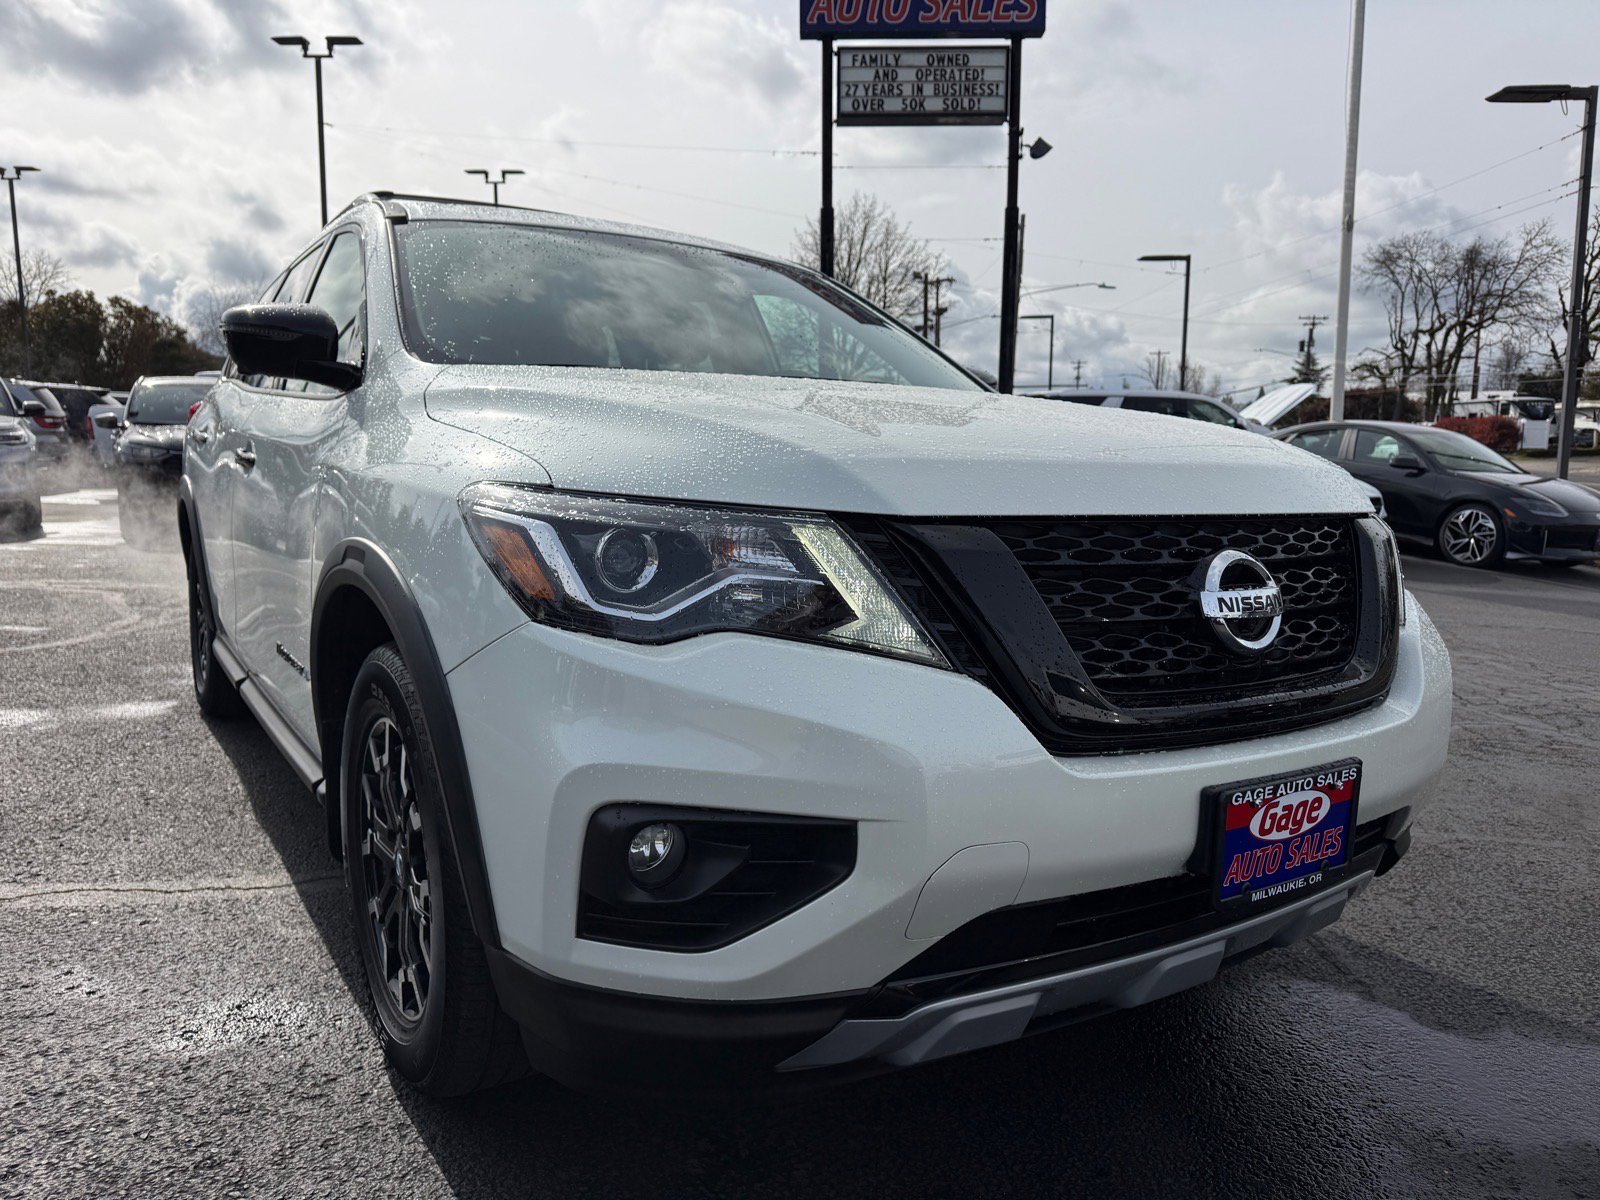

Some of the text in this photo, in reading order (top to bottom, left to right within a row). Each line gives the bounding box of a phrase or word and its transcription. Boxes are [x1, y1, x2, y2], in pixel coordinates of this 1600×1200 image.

[852, 54, 969, 67] FAMILY OWNED
[874, 69, 985, 81] AND OPERATED!
[845, 83, 1000, 96] 27 YEARS IN BUSINESS!
[852, 98, 981, 111] OVER 50K SOLD!
[1217, 593, 1282, 613] NISSAN
[1232, 767, 1357, 806] GAGE AUTO SALES
[1258, 796, 1323, 837] Gage
[1223, 826, 1344, 887] AUTO SALES
[1251, 873, 1323, 902] MILWAUKIE, OR
